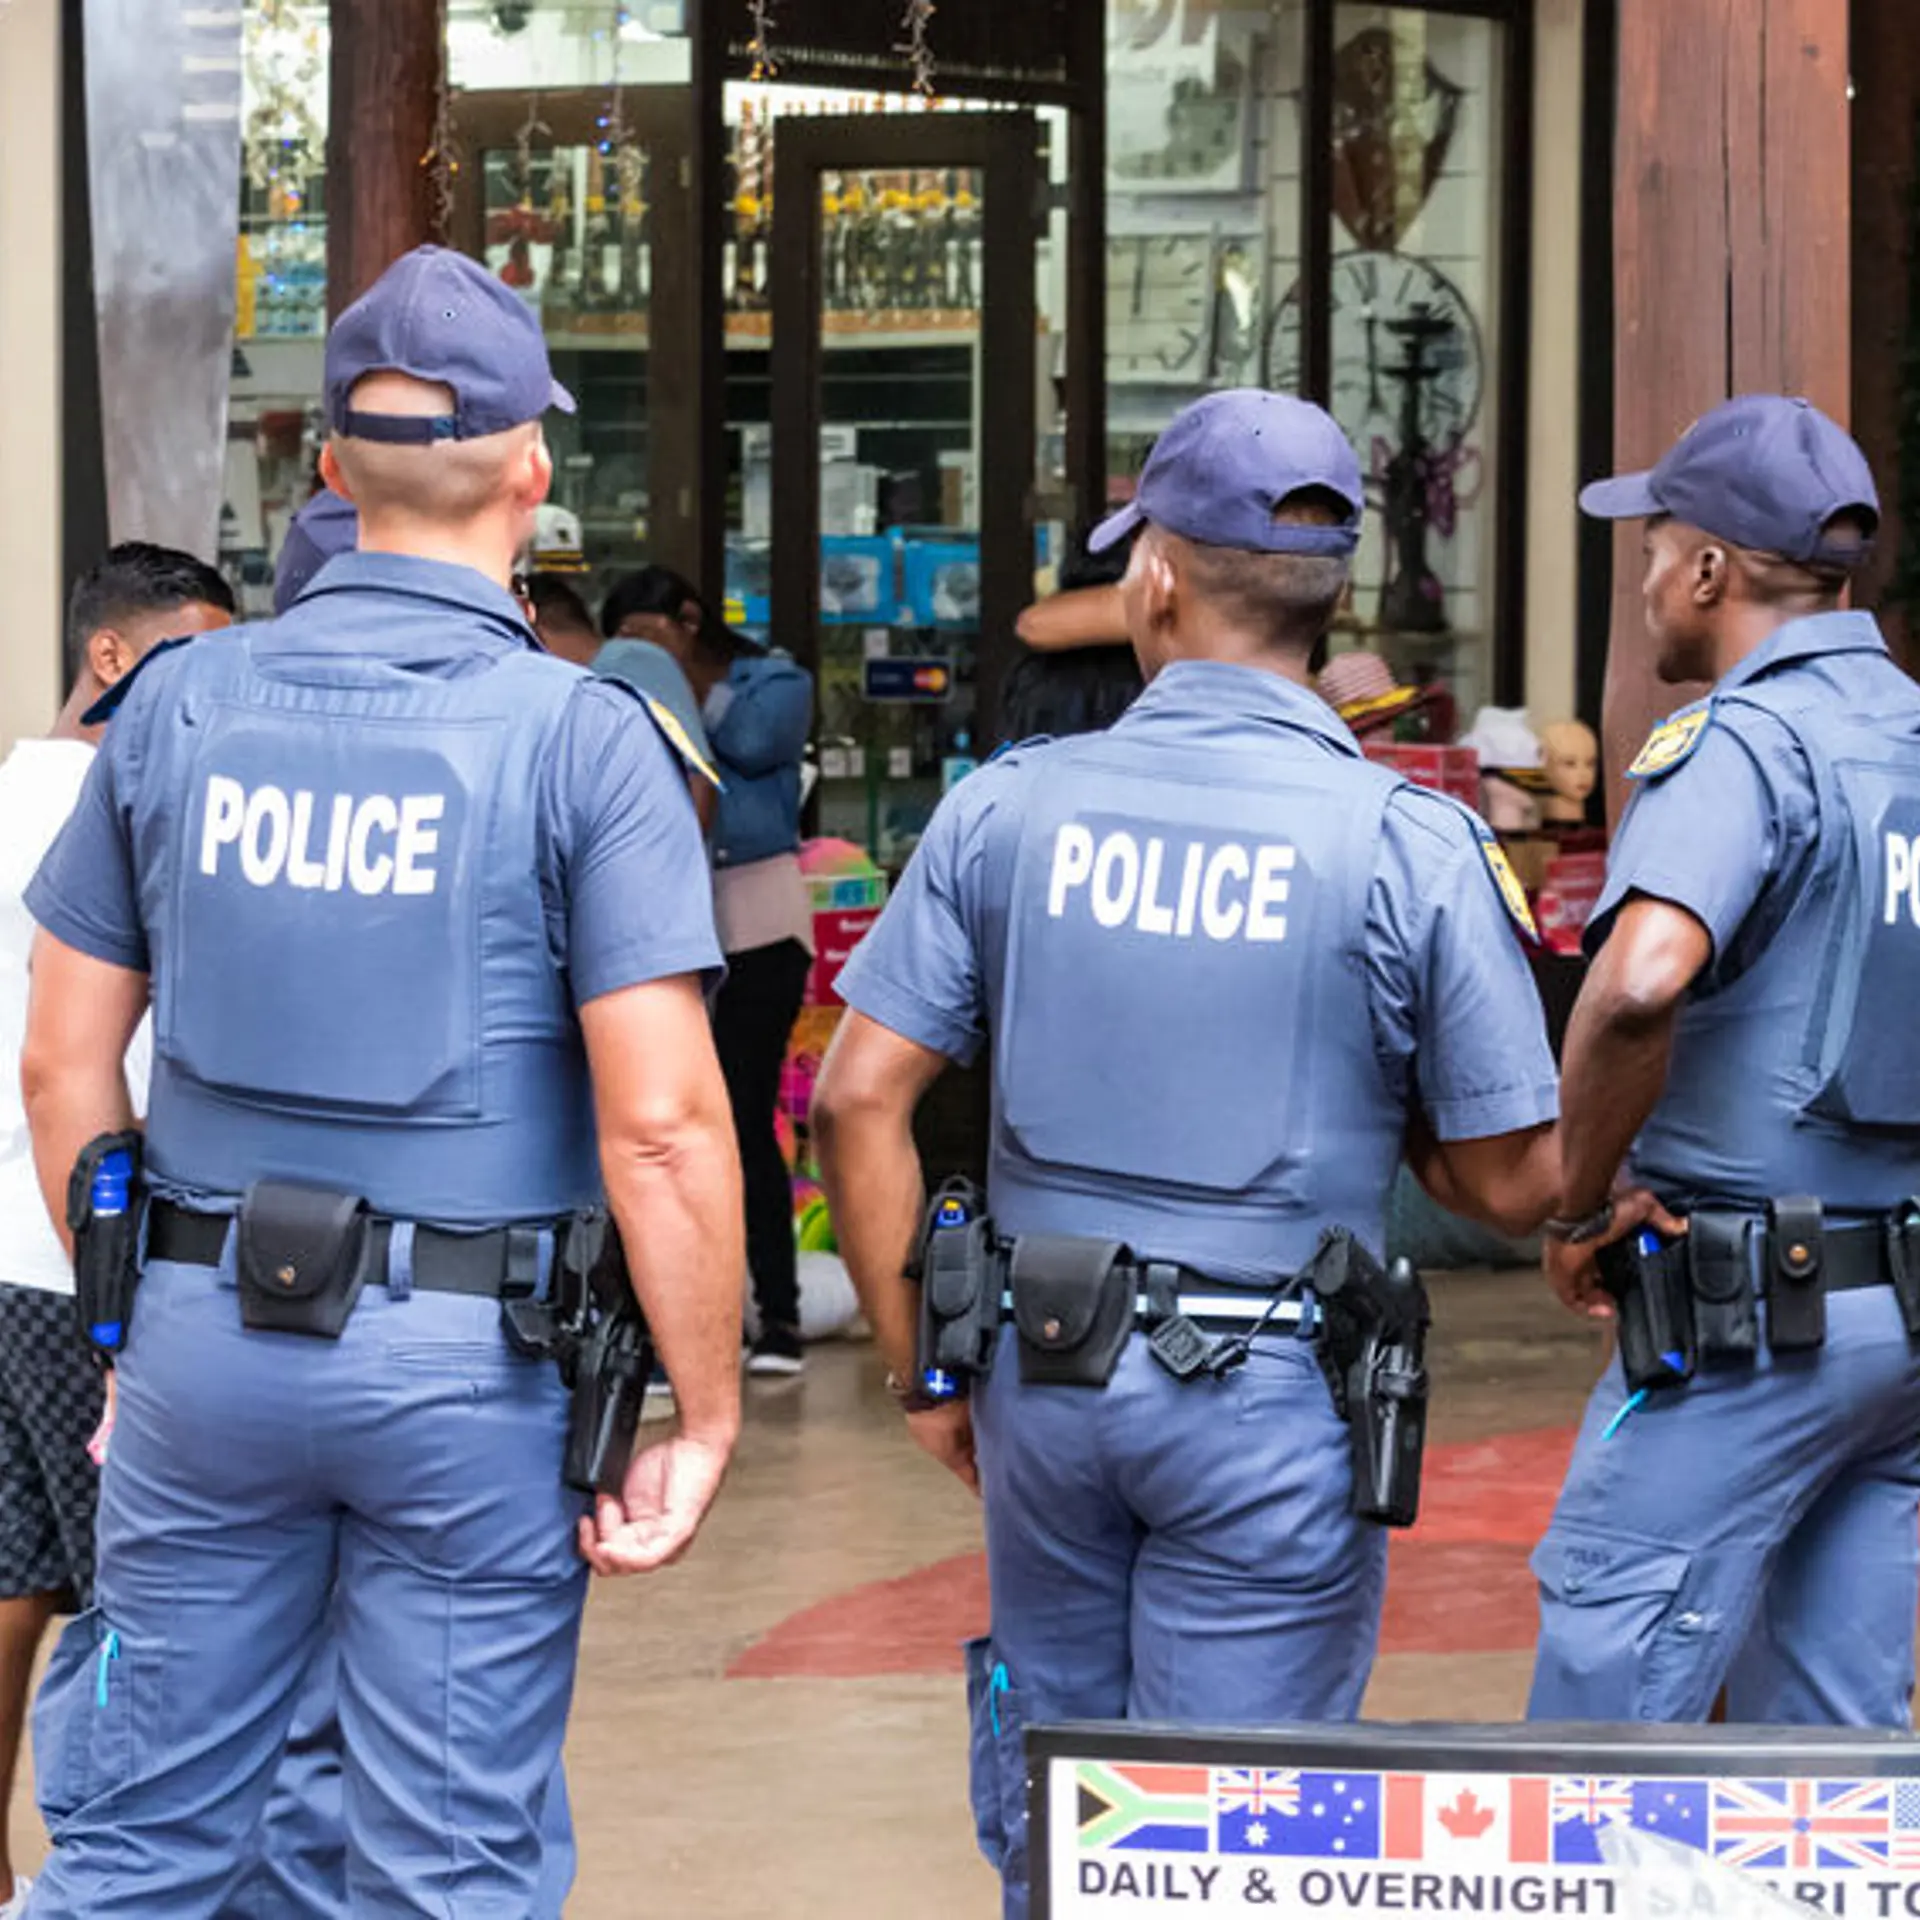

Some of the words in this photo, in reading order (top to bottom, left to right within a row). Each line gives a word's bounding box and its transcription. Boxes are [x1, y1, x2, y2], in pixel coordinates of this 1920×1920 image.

[200, 773, 446, 895] POLICE
[1047, 822, 1296, 942] POLICE
[1078, 1859, 1221, 1901] DAILY
[1242, 1867, 1278, 1904] &
[1299, 1869, 1616, 1915] OVERNIGHT
